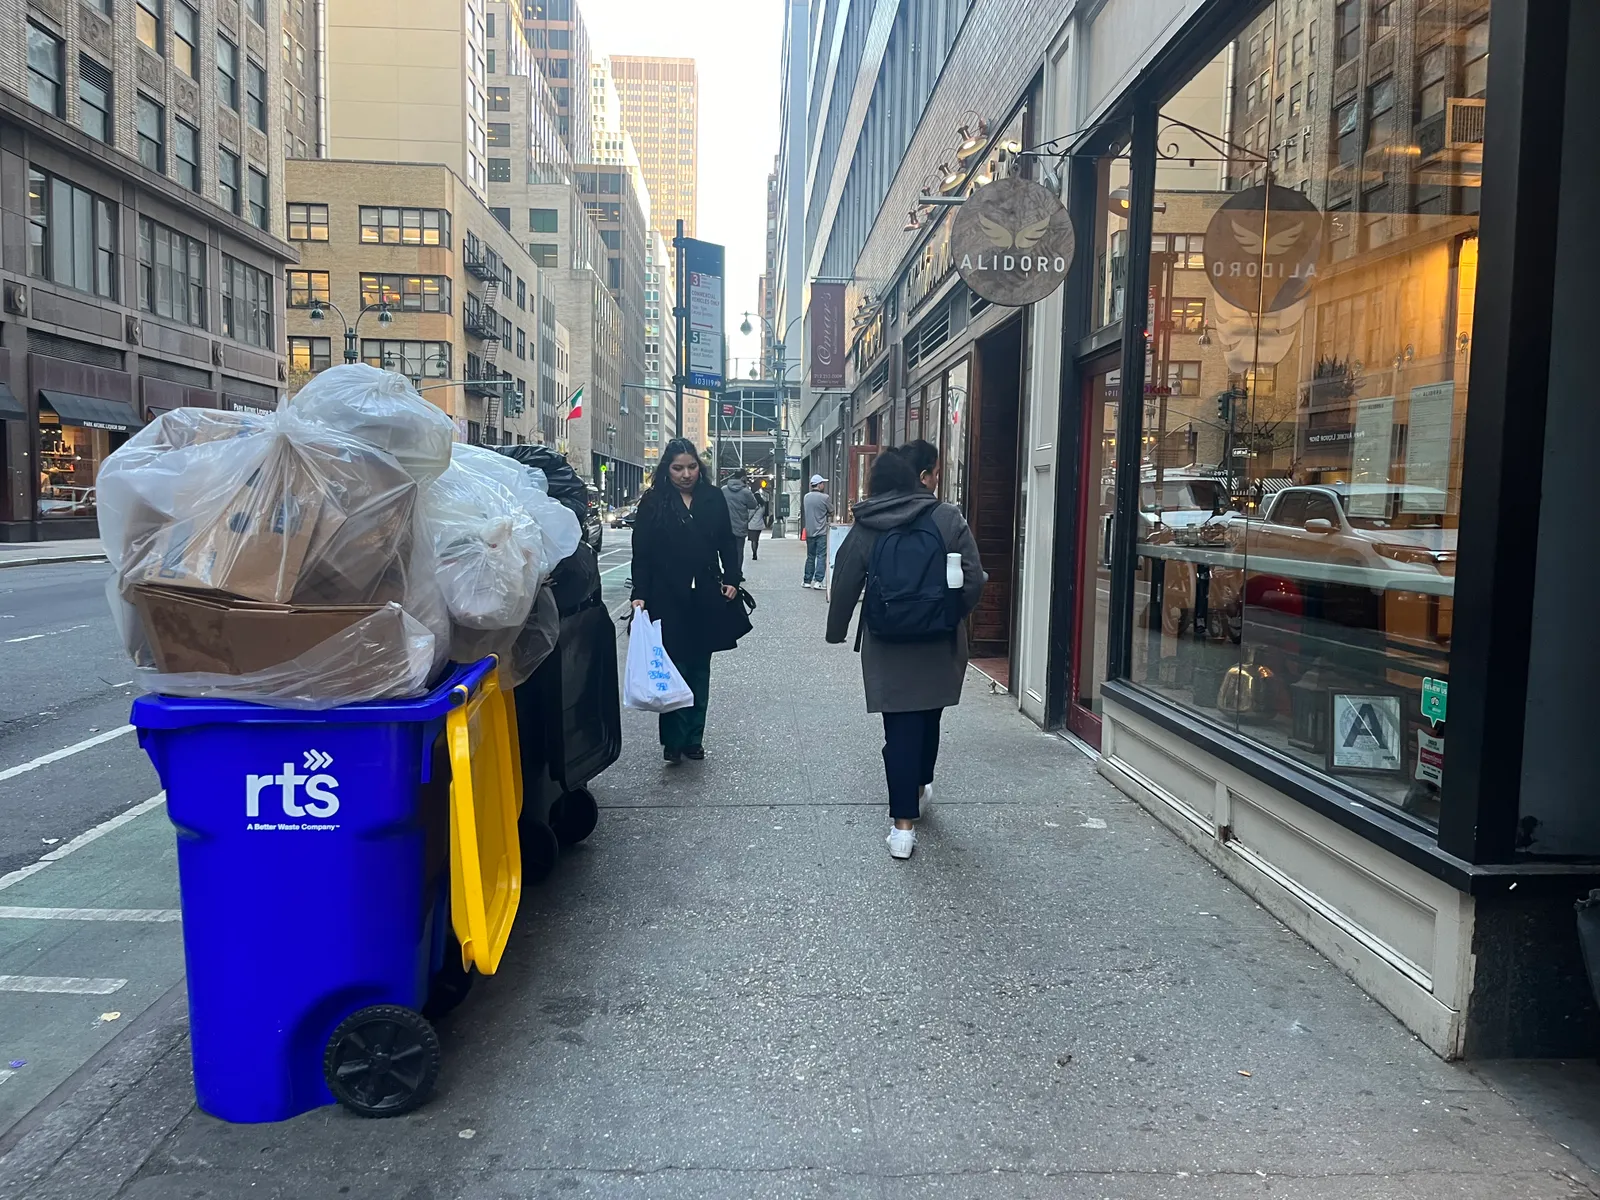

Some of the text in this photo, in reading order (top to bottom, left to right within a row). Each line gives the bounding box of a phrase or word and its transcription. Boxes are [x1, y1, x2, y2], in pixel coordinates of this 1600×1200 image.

[960, 253, 1065, 273] ALIDORO
[692, 274, 699, 286] 3
[692, 331, 699, 343] 5
[1343, 703, 1388, 750] A
[246, 762, 340, 818] rts
[246, 823, 254, 831] A
[254, 823, 277, 831] Better
[277, 823, 300, 831] Waste
